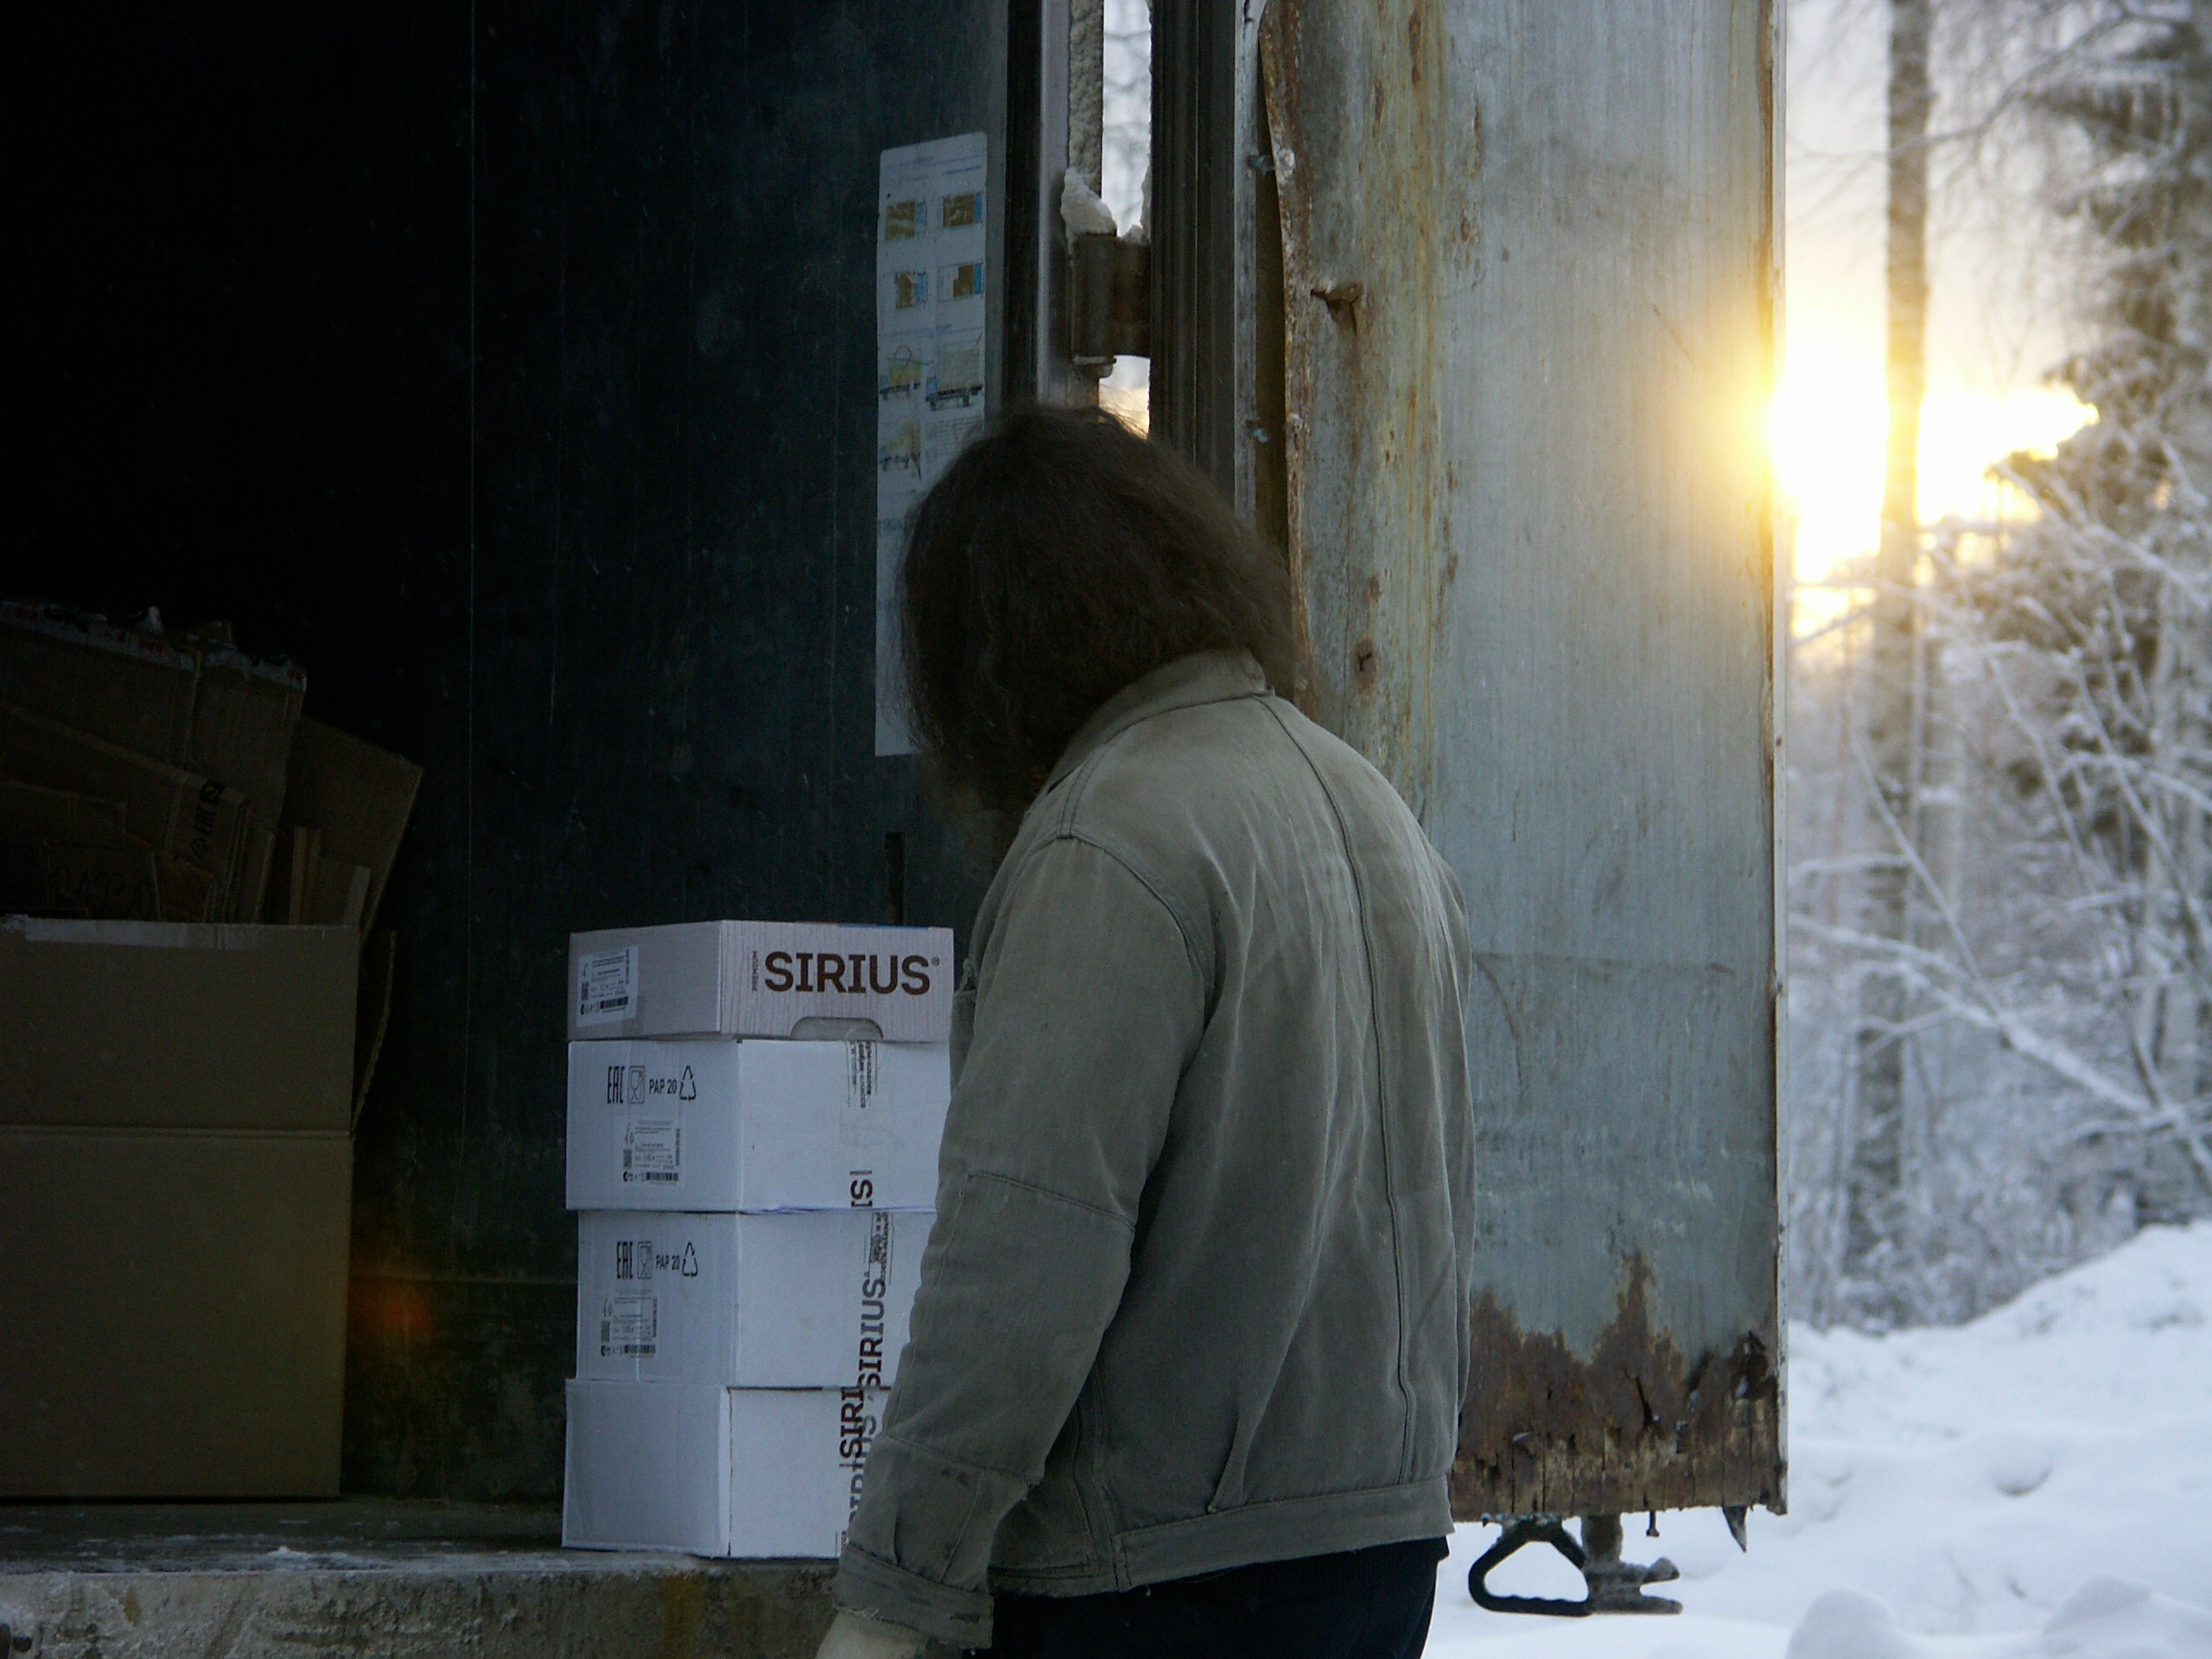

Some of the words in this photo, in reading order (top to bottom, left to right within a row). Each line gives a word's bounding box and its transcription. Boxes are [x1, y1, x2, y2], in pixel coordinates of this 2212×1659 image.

[765, 950, 931, 995] SIRIUS
[649, 1078, 665, 1094] PAP
[667, 1078, 677, 1095] 20
[671, 1254, 681, 1270] 20
[856, 1278, 887, 1388] SIRIUS
